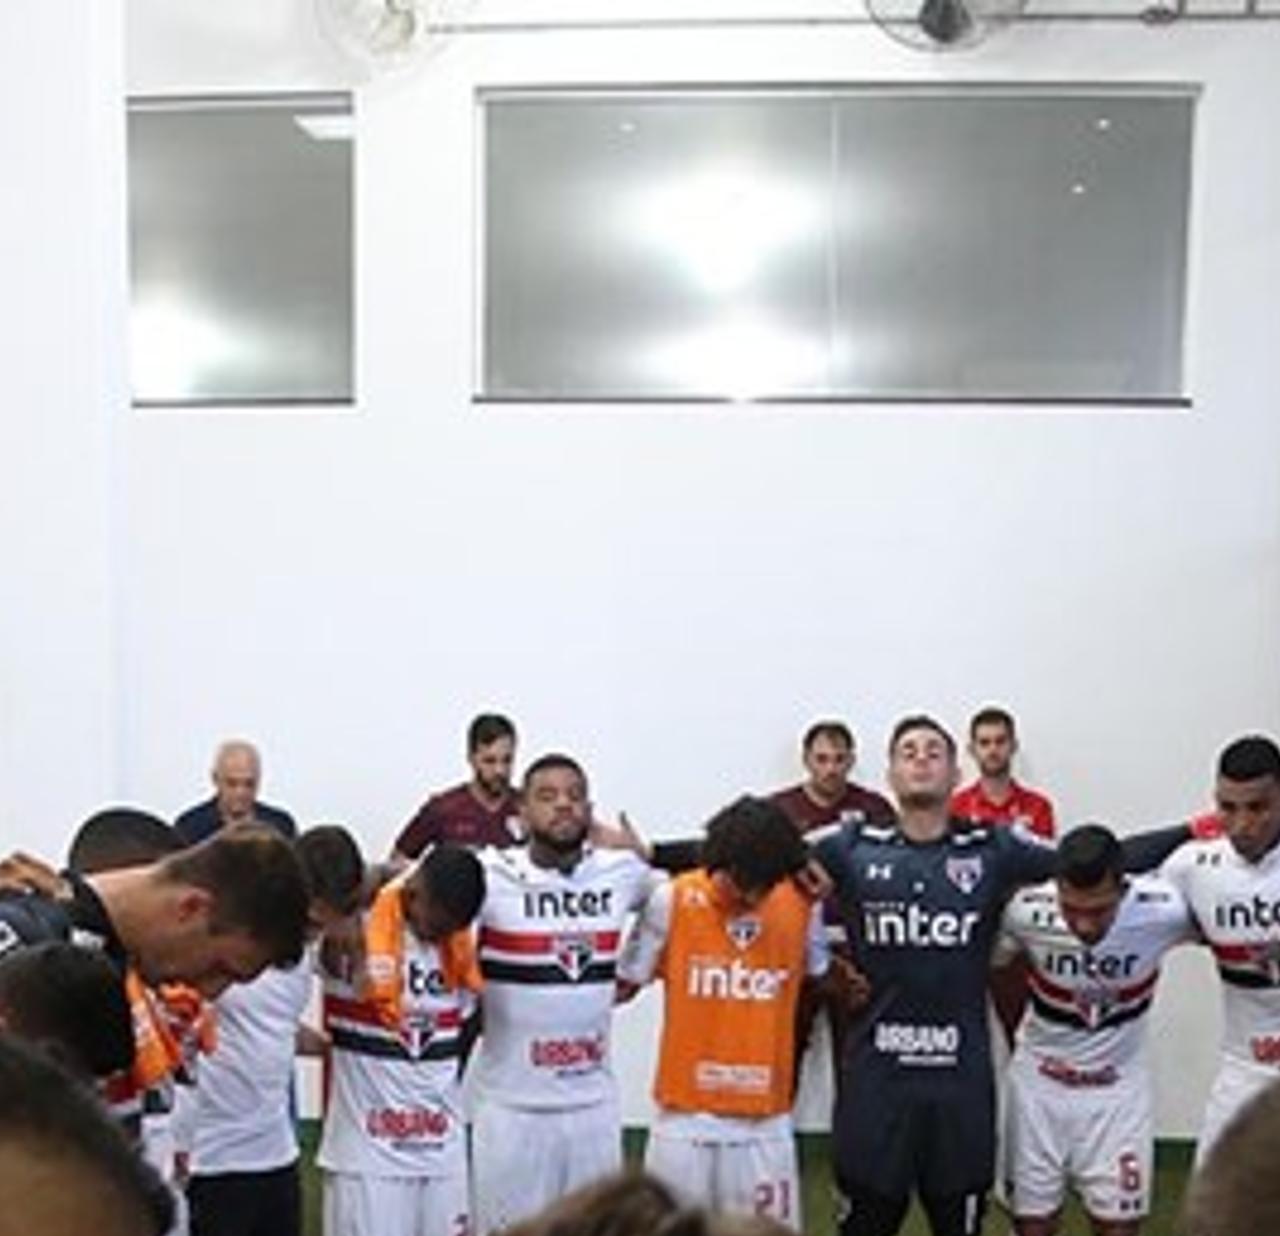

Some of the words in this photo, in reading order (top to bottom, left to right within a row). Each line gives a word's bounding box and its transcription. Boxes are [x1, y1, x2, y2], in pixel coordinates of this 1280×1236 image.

[523, 888, 613, 918] inter
[863, 903, 980, 946] inter
[687, 958, 790, 1000] inter
[1045, 950, 1140, 979] inter
[1119, 1152, 1142, 1193] 6
[754, 1180, 790, 1222] 21
